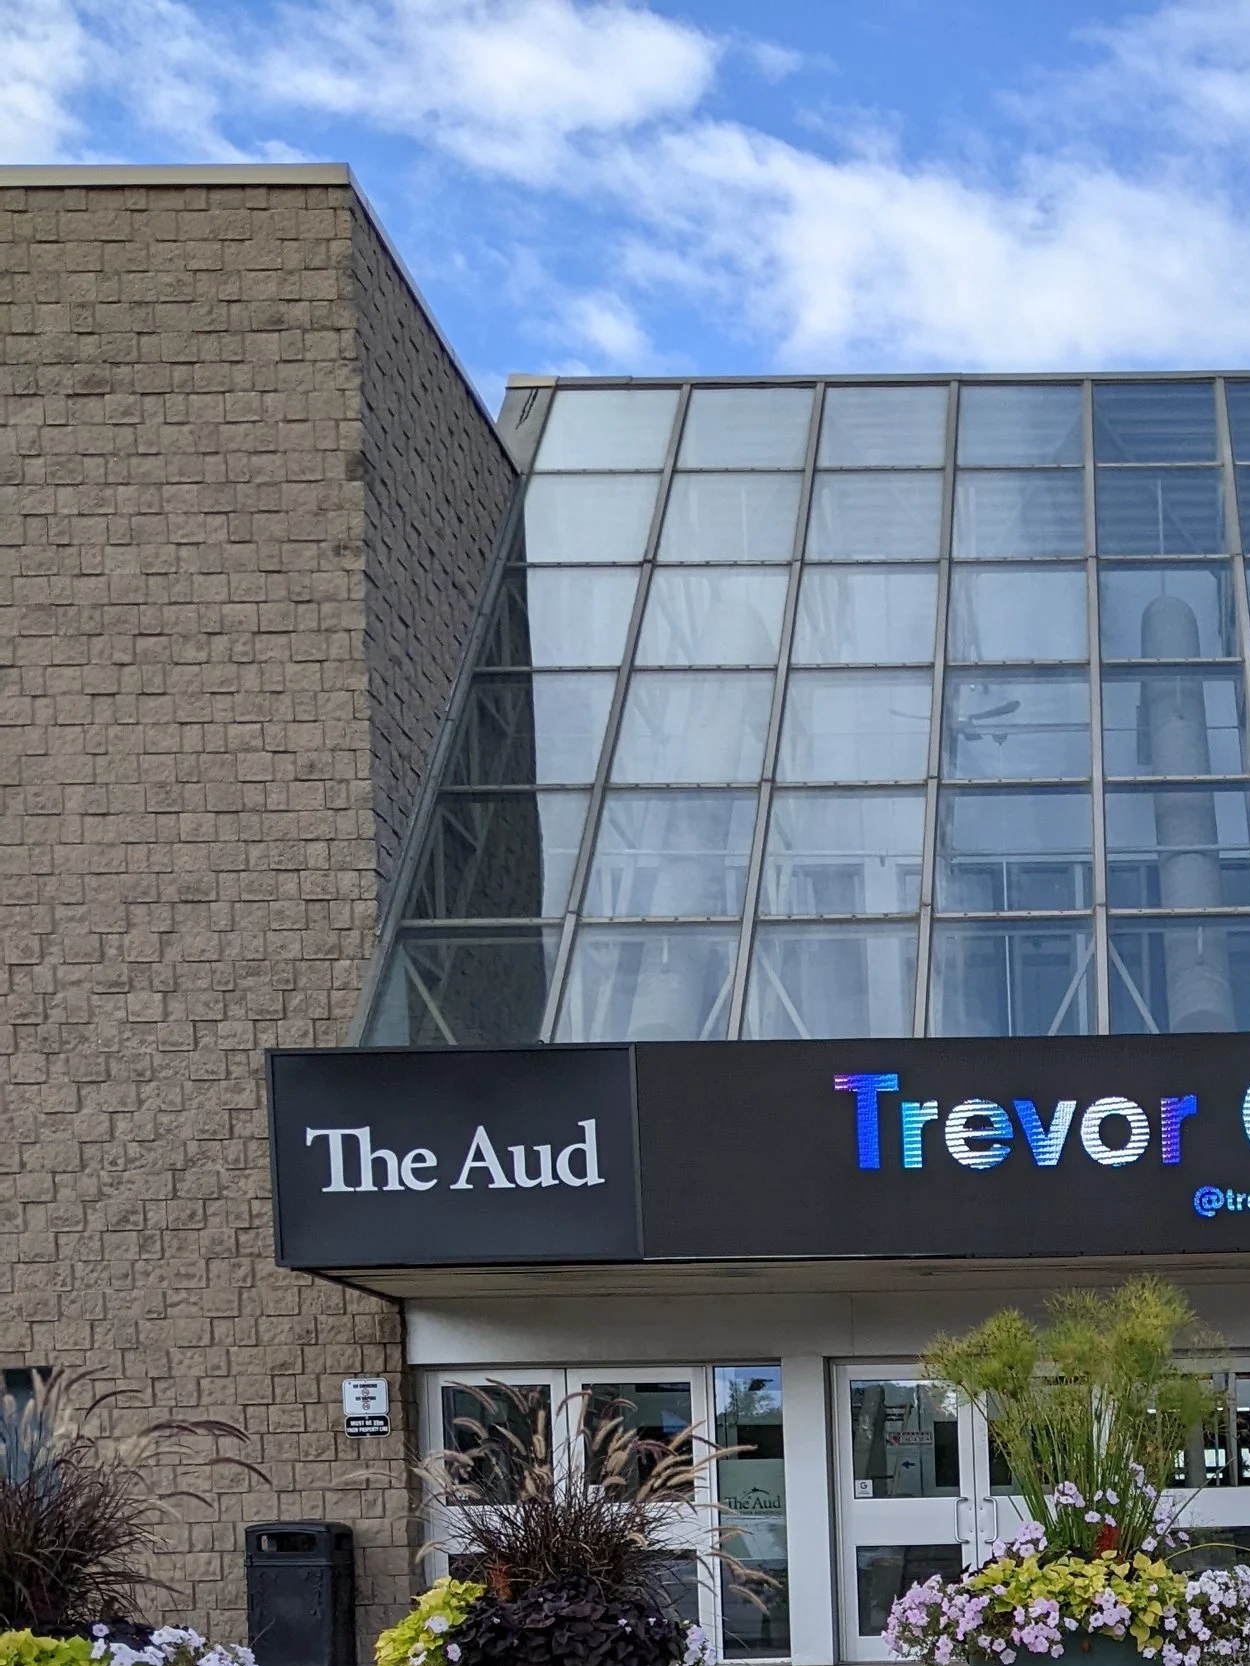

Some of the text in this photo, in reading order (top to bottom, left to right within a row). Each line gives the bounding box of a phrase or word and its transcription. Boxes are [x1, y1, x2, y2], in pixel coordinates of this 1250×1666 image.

[305, 1118, 606, 1193] The Aud
[833, 1072, 1199, 1171] Trevor
[724, 1495, 781, 1510] The Aud
